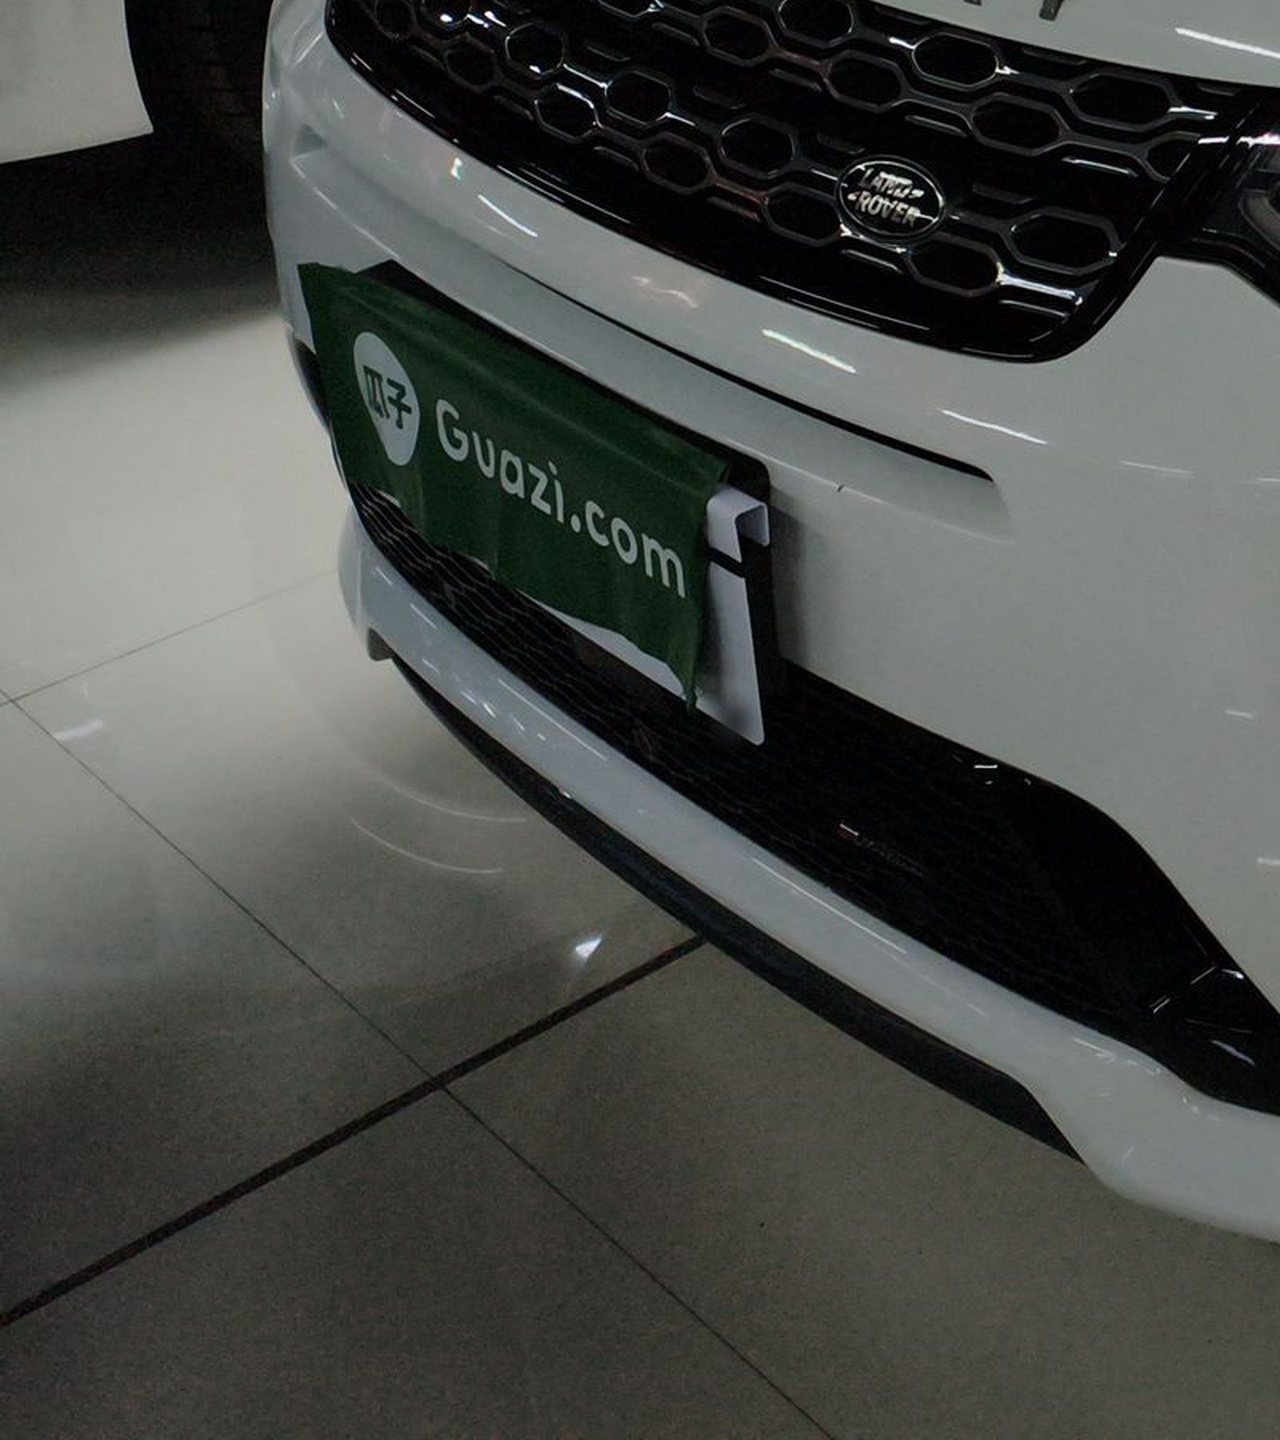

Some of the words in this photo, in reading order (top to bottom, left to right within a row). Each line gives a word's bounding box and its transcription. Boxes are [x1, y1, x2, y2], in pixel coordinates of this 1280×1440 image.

[855, 190, 921, 228] ROVER
[362, 364, 412, 430] 瓜子
[436, 397, 687, 598] Guazi.com
